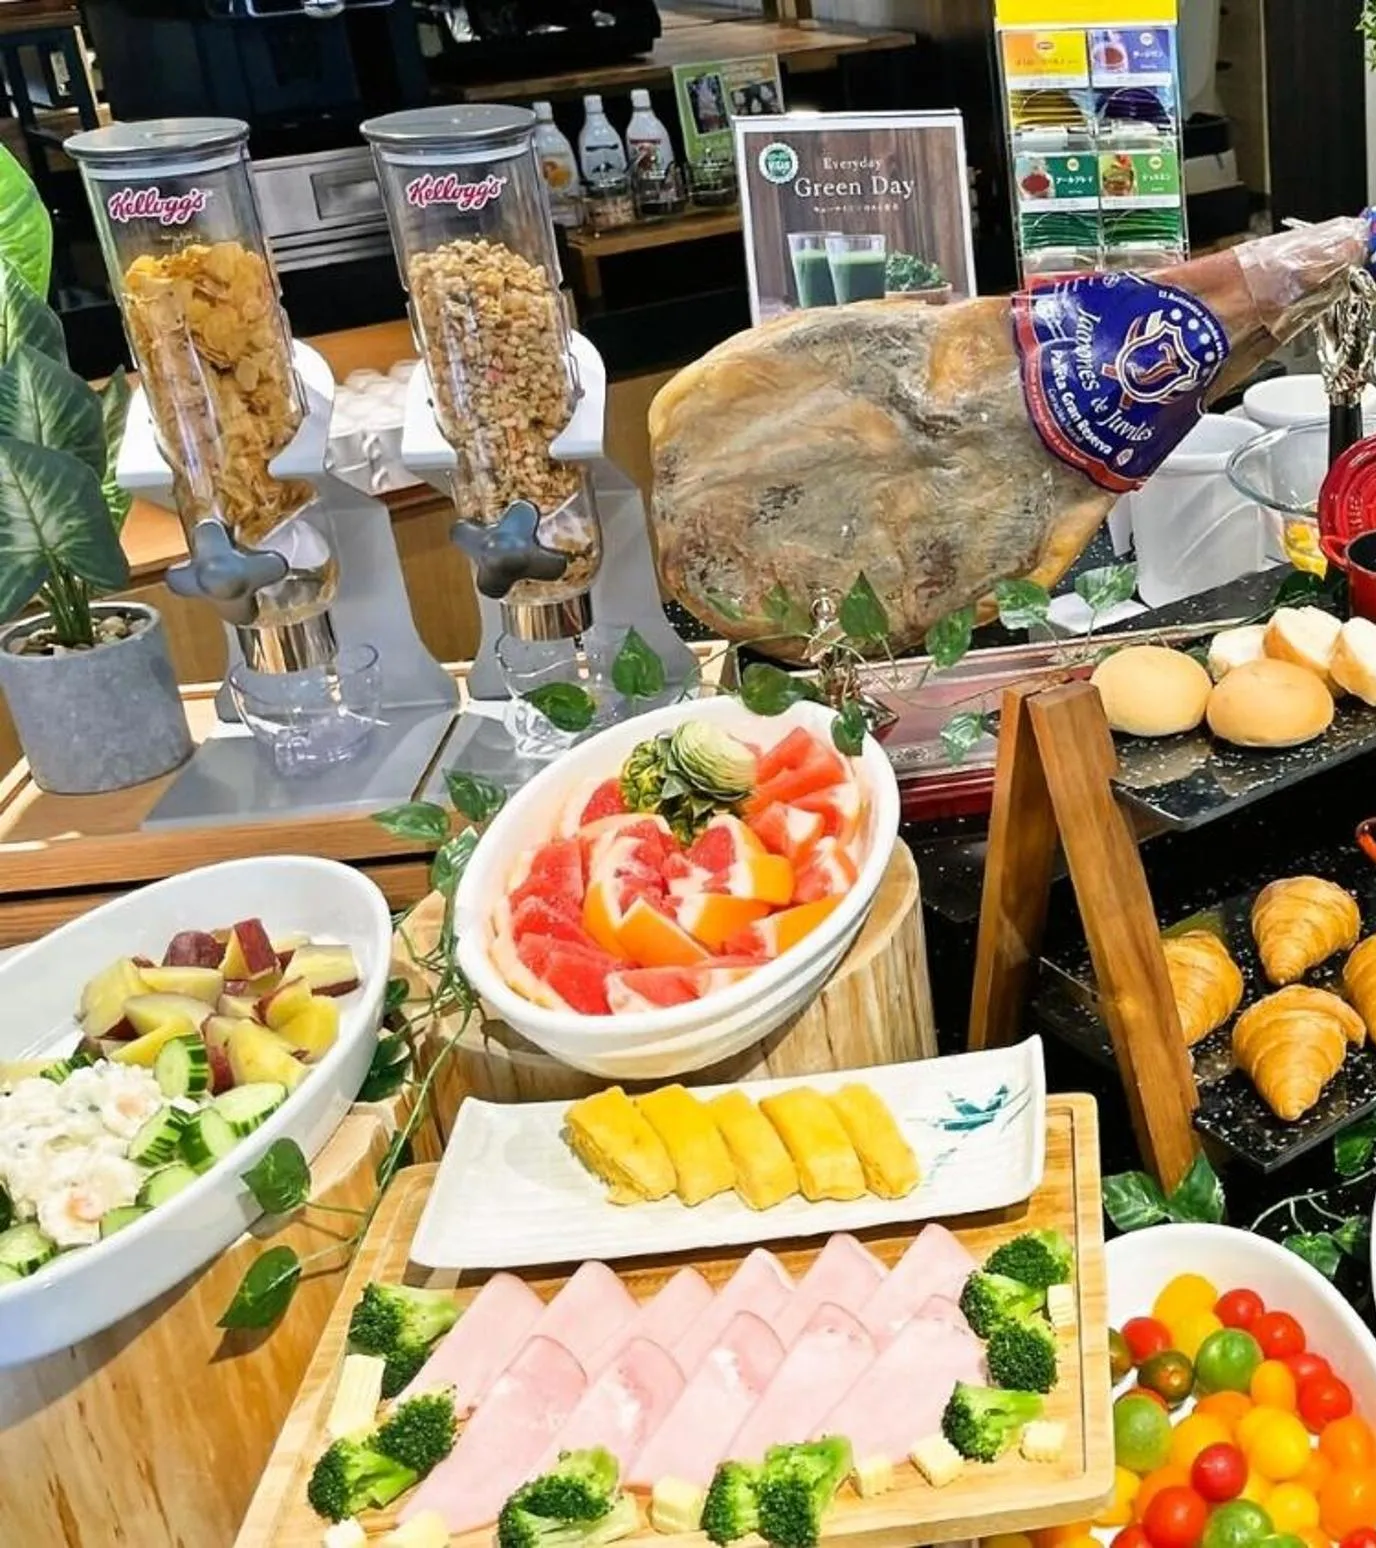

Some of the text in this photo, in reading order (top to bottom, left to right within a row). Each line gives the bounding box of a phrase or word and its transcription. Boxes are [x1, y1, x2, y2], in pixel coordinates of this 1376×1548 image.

[823, 156, 882, 172] Everyday
[108, 187, 207, 224] Kellogg's
[405, 173, 501, 211] Kellogg's
[794, 175, 915, 199] Green Day
[1075, 307, 1101, 392] Jamones
[1097, 409, 1154, 441] Juviles
[1061, 391, 1081, 422] Gran
[1077, 419, 1113, 455] Reserva
